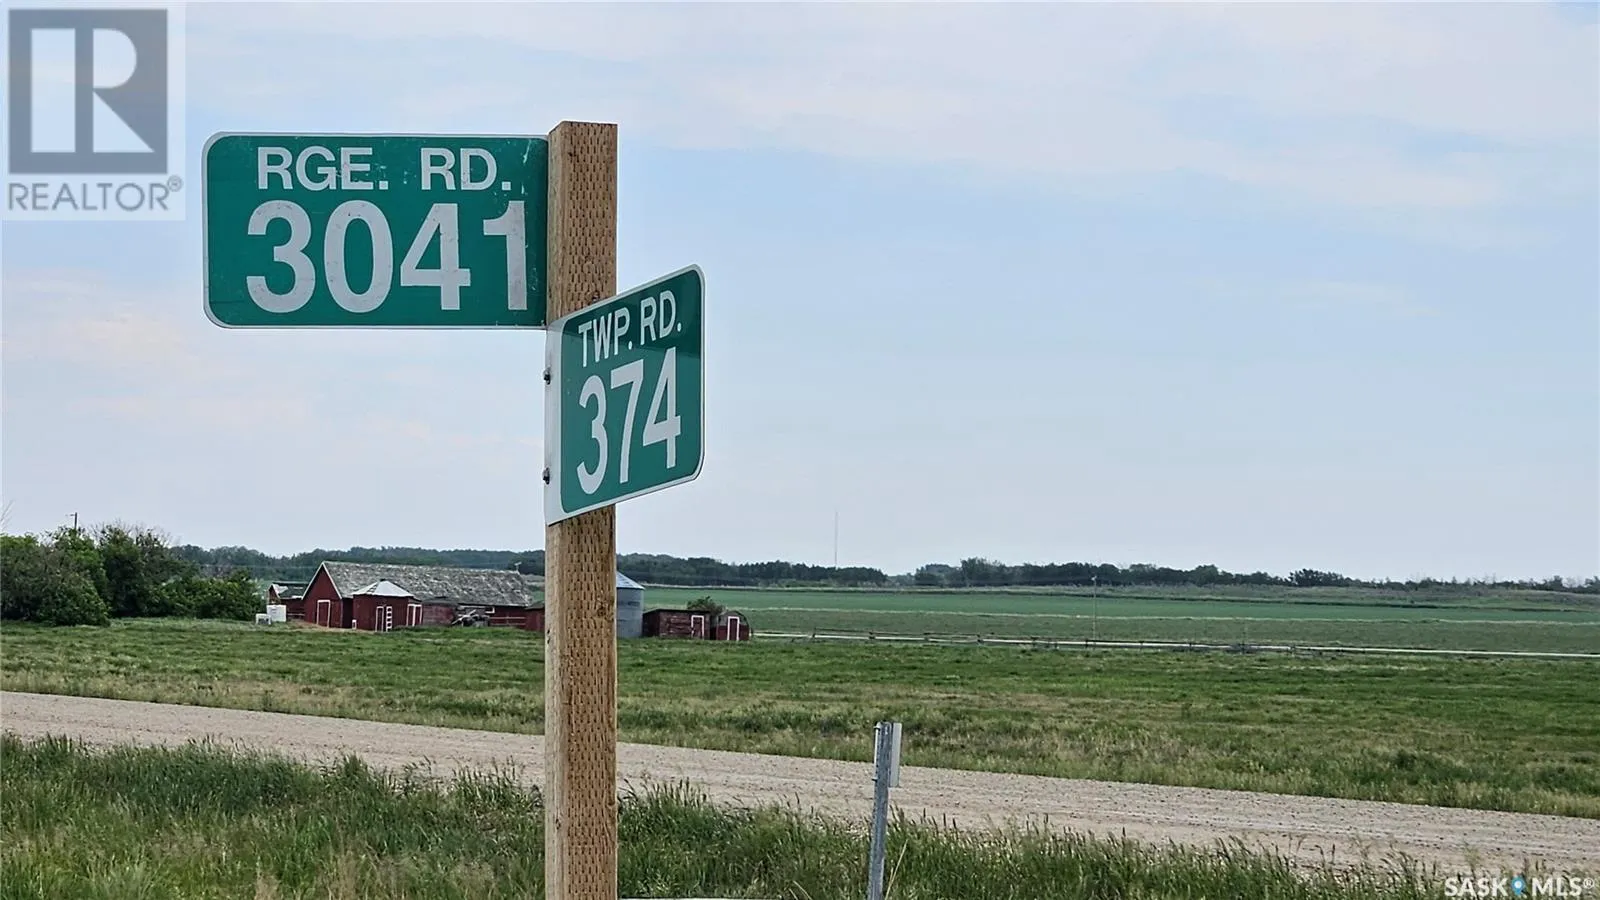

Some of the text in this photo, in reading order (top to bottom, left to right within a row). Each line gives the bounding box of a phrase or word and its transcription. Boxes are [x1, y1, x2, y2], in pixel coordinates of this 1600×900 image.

[257, 145, 512, 191] RGE. RD.
[246, 200, 528, 314] 3041
[578, 290, 682, 367] TWP. RD.
[576, 347, 682, 495] 374
